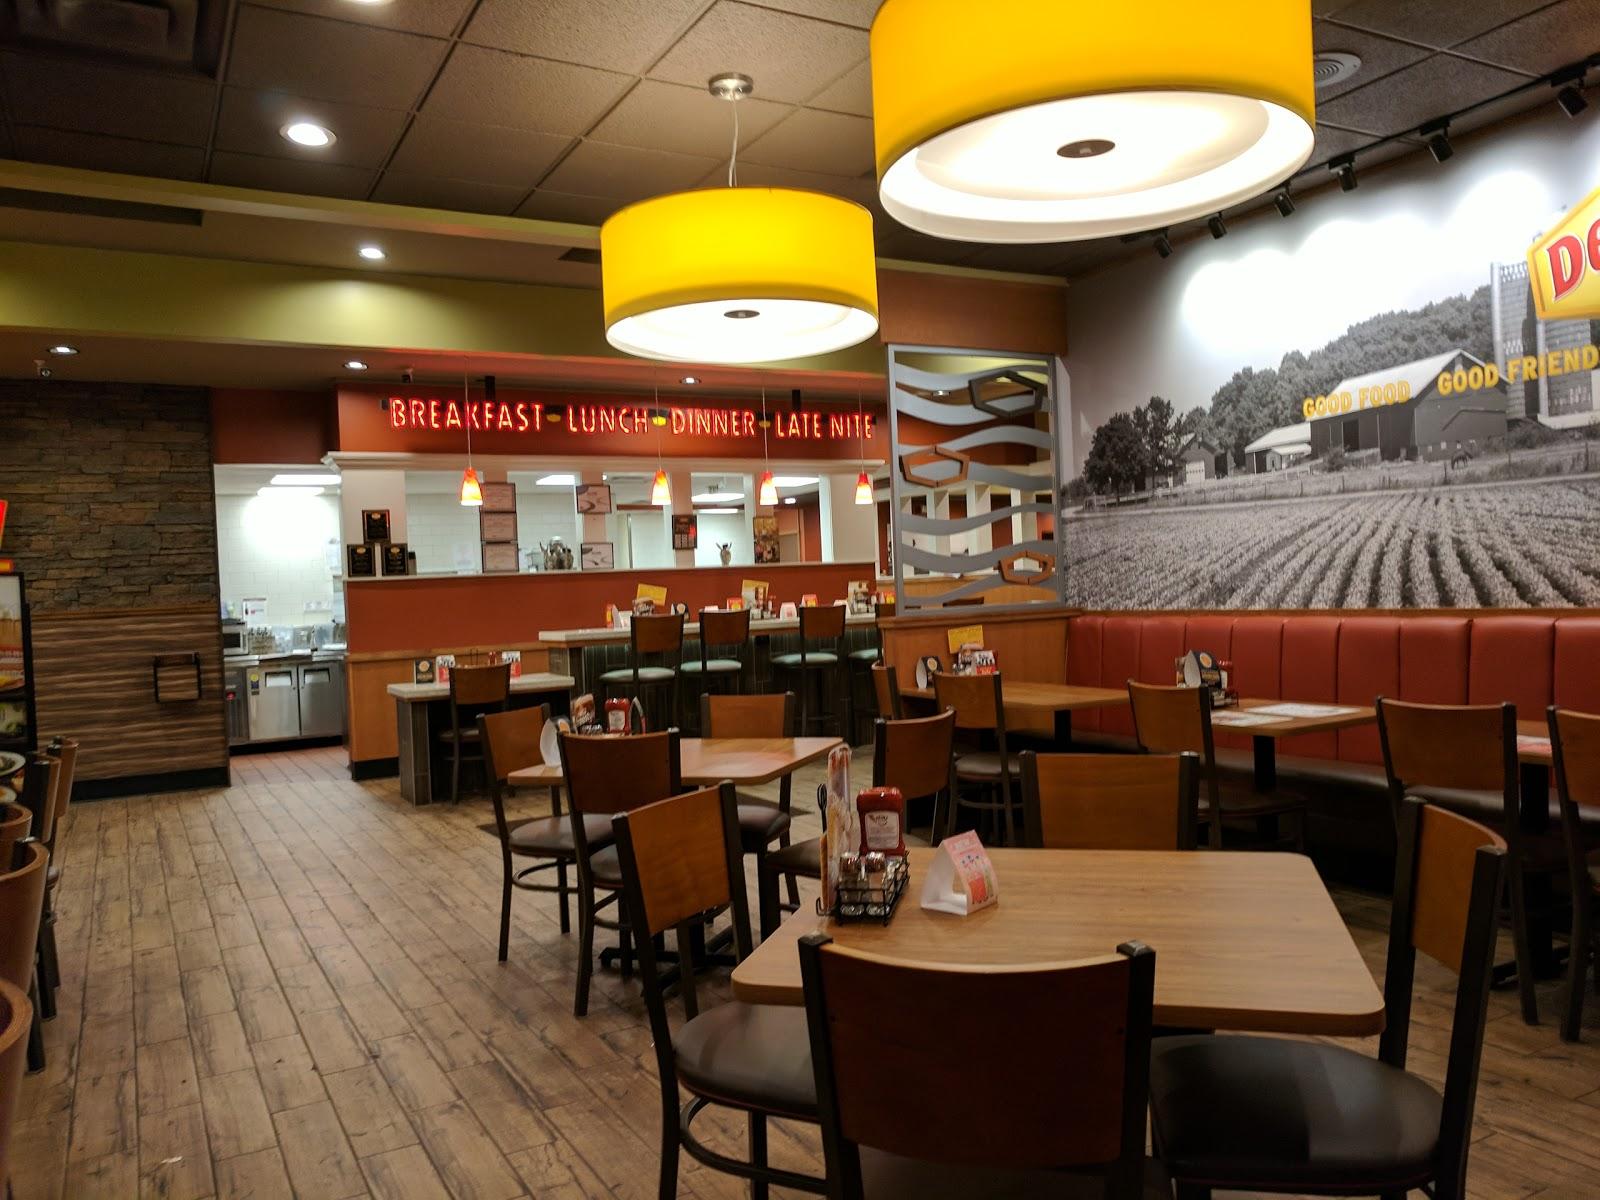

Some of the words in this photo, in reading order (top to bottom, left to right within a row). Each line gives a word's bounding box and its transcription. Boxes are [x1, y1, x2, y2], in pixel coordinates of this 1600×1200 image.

[1302, 392, 1353, 418] GOOD
[1358, 379, 1411, 411] FOOD
[1437, 362, 1500, 397] GOOD
[1506, 343, 1600, 385] FRIEND
[389, 398, 543, 431] BREAKFAST
[567, 404, 650, 434] LUNCH
[669, 407, 756, 436] DINNER
[774, 411, 822, 440] LATE
[829, 412, 873, 440] NITE
